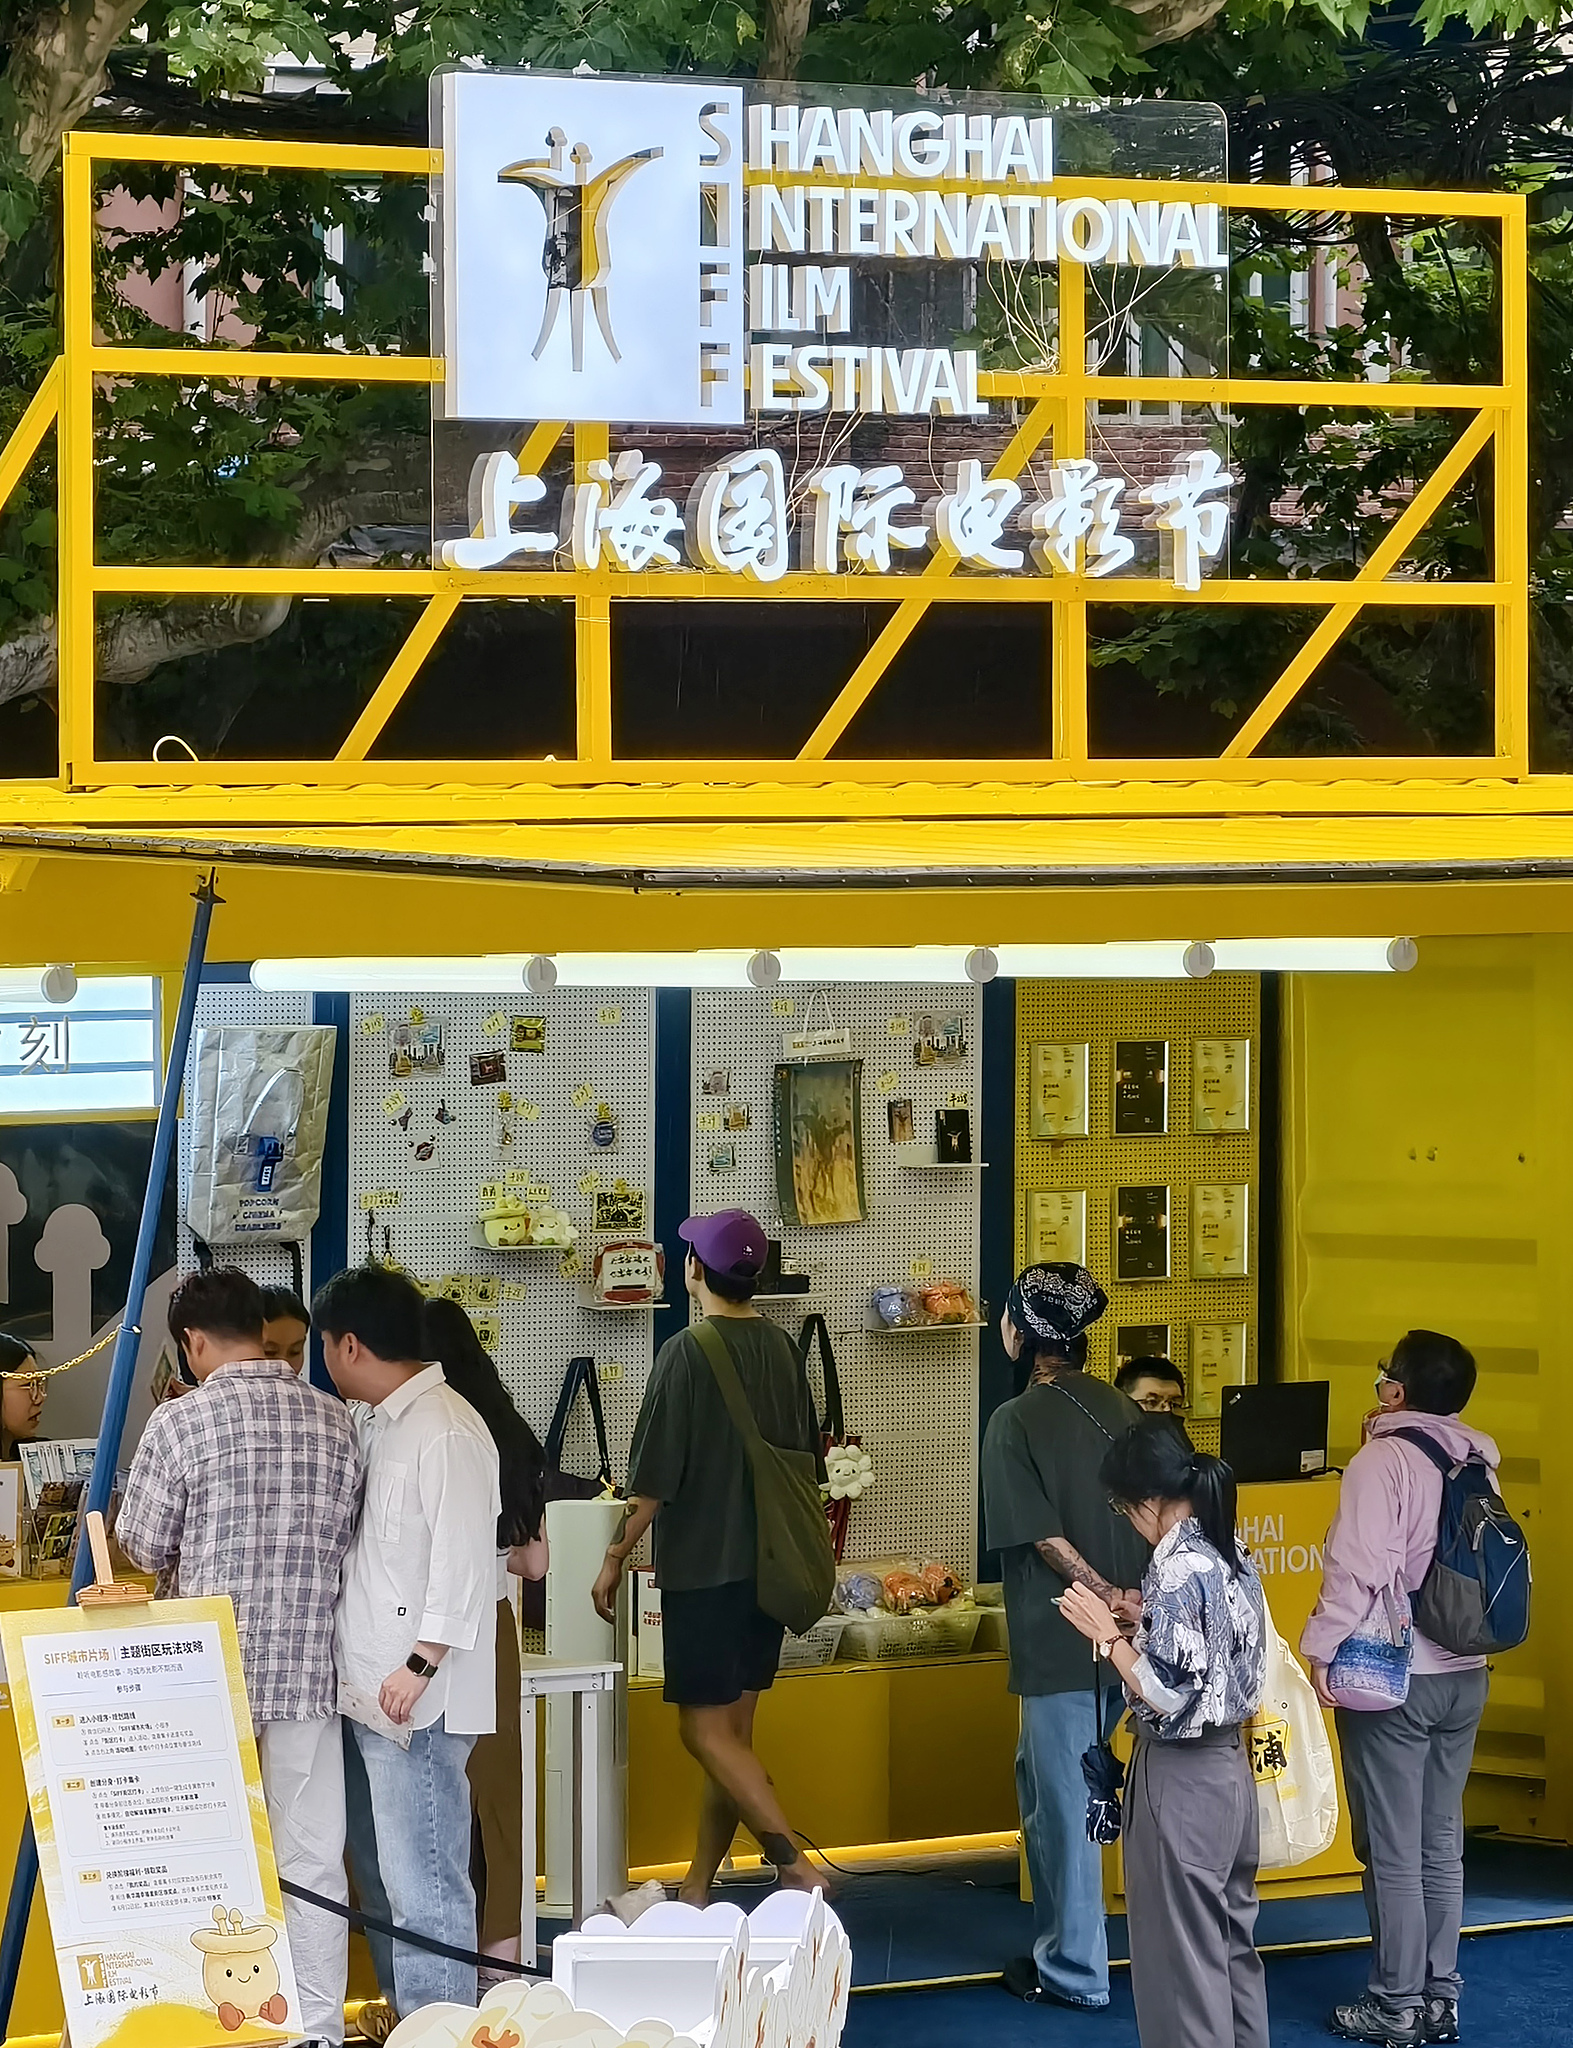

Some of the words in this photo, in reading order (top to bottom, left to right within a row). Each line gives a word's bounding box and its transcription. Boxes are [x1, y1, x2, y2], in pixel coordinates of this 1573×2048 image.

[433, 448, 1235, 591] 上海国际电影节
[18, 1015, 69, 1073] 刻
[44, 1648, 110, 1665] SIFF城市片场
[120, 1640, 204, 1660] 主题街区玩法攻略
[1253, 1730, 1287, 1773] 浦
